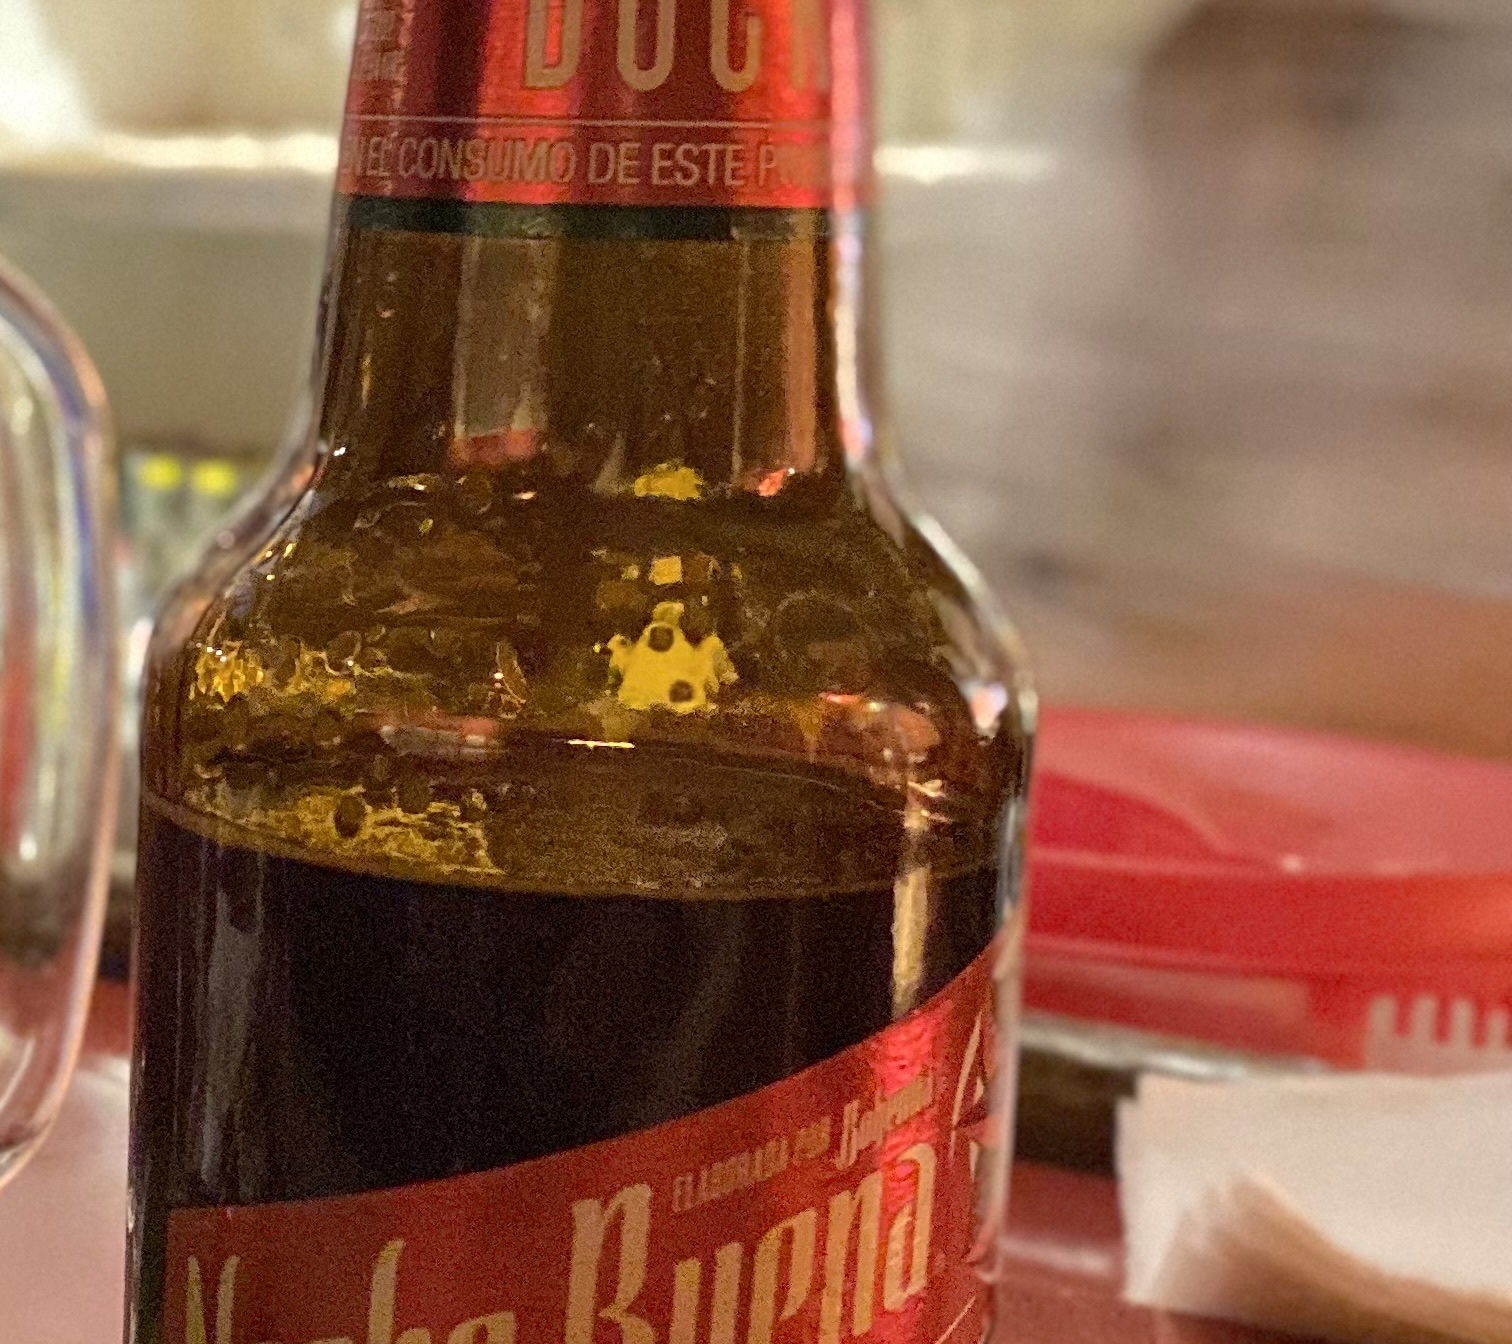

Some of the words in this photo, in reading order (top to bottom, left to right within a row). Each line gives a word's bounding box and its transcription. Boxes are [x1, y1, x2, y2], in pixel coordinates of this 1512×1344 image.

[398, 137, 577, 186] CONSUMO
[587, 142, 641, 185] DE
[650, 142, 745, 187] ESTE
